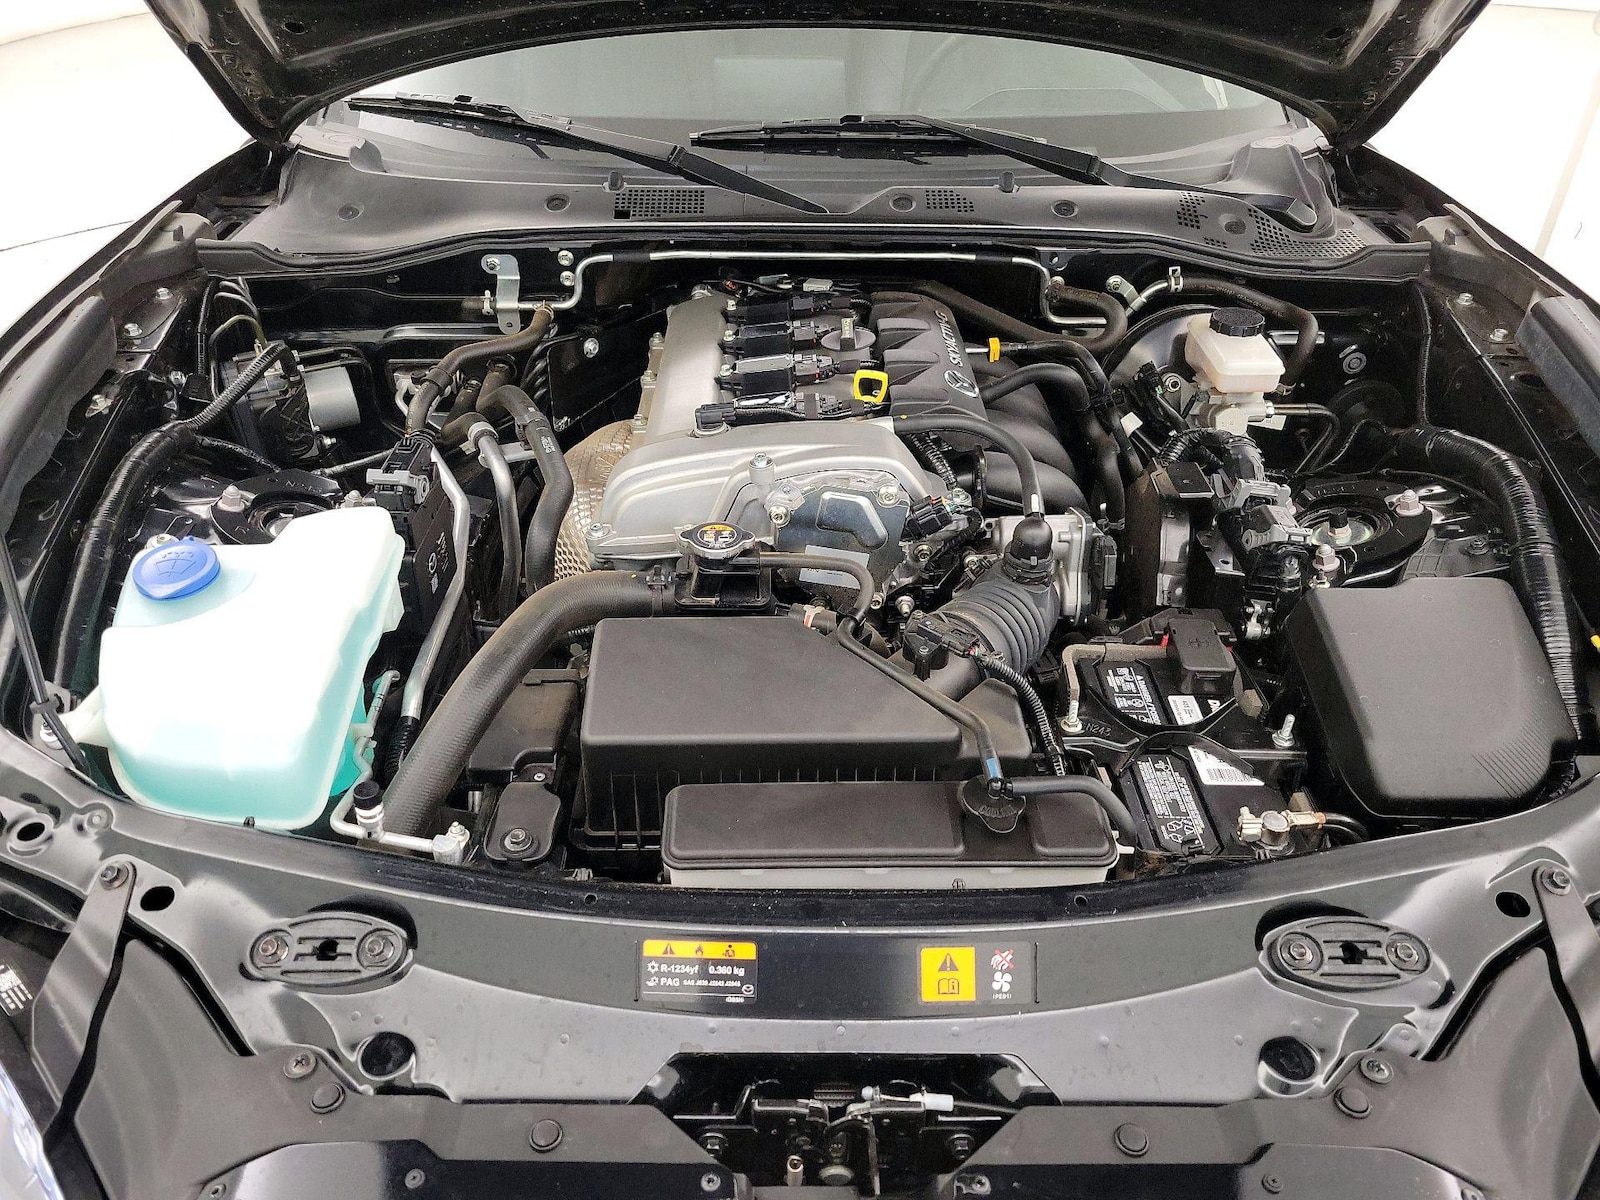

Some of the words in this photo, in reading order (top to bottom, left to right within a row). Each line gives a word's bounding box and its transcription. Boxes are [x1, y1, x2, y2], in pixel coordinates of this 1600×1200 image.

[660, 964, 699, 974] R-1234yf
[709, 966, 732, 974] 0.360
[734, 966, 745, 976] kg
[660, 978, 680, 986] PAG
